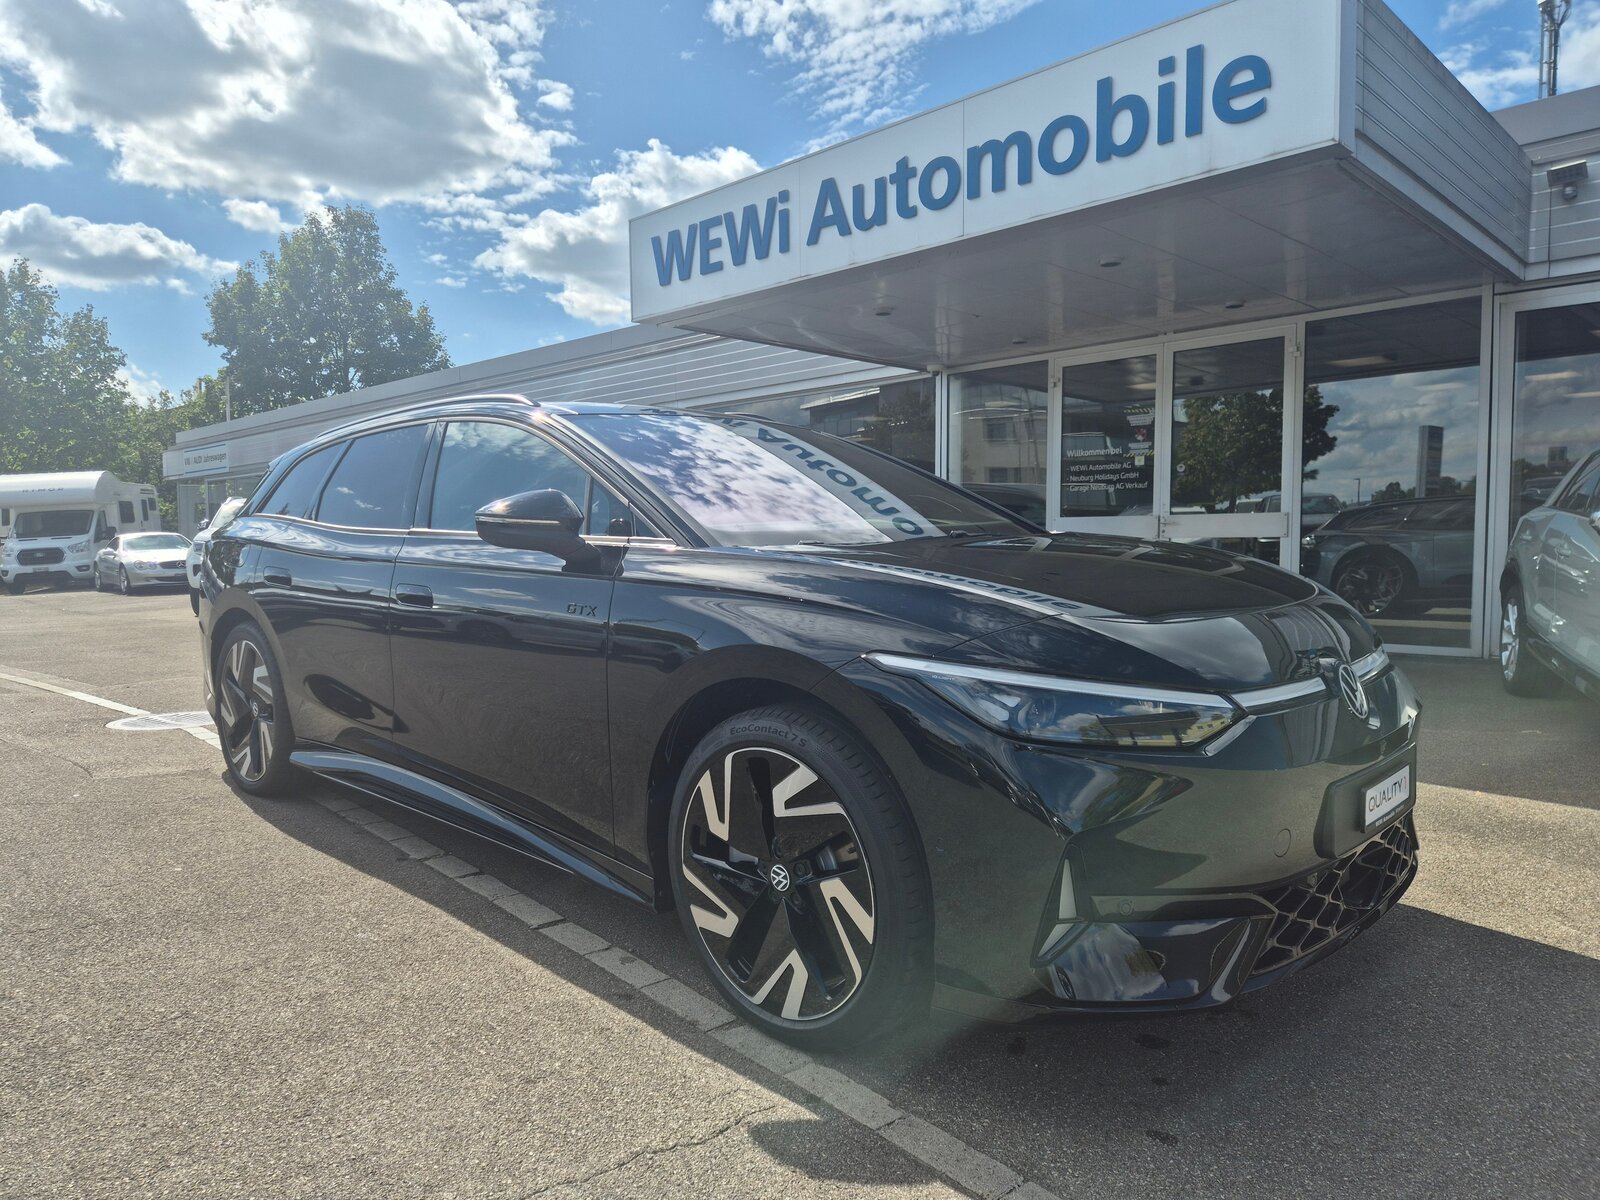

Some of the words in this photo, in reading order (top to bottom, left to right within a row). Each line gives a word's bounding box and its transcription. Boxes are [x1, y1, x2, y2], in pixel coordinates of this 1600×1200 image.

[651, 190, 790, 287] WEWi
[806, 44, 1272, 246] Automobile
[1066, 449, 1110, 457] Willkommen
[1070, 464, 1088, 472] WEWi
[1088, 462, 1121, 471] Automobile
[1122, 461, 1132, 469] AG
[1070, 475, 1094, 483] Neuburg
[1094, 473, 1120, 481] Holidays
[1120, 471, 1140, 480] GmbH
[1125, 481, 1148, 489] Verkauf
[567, 603, 598, 616] GTX
[730, 724, 789, 739] EcoContact
[791, 733, 799, 743] 7
[799, 738, 807, 748] S
